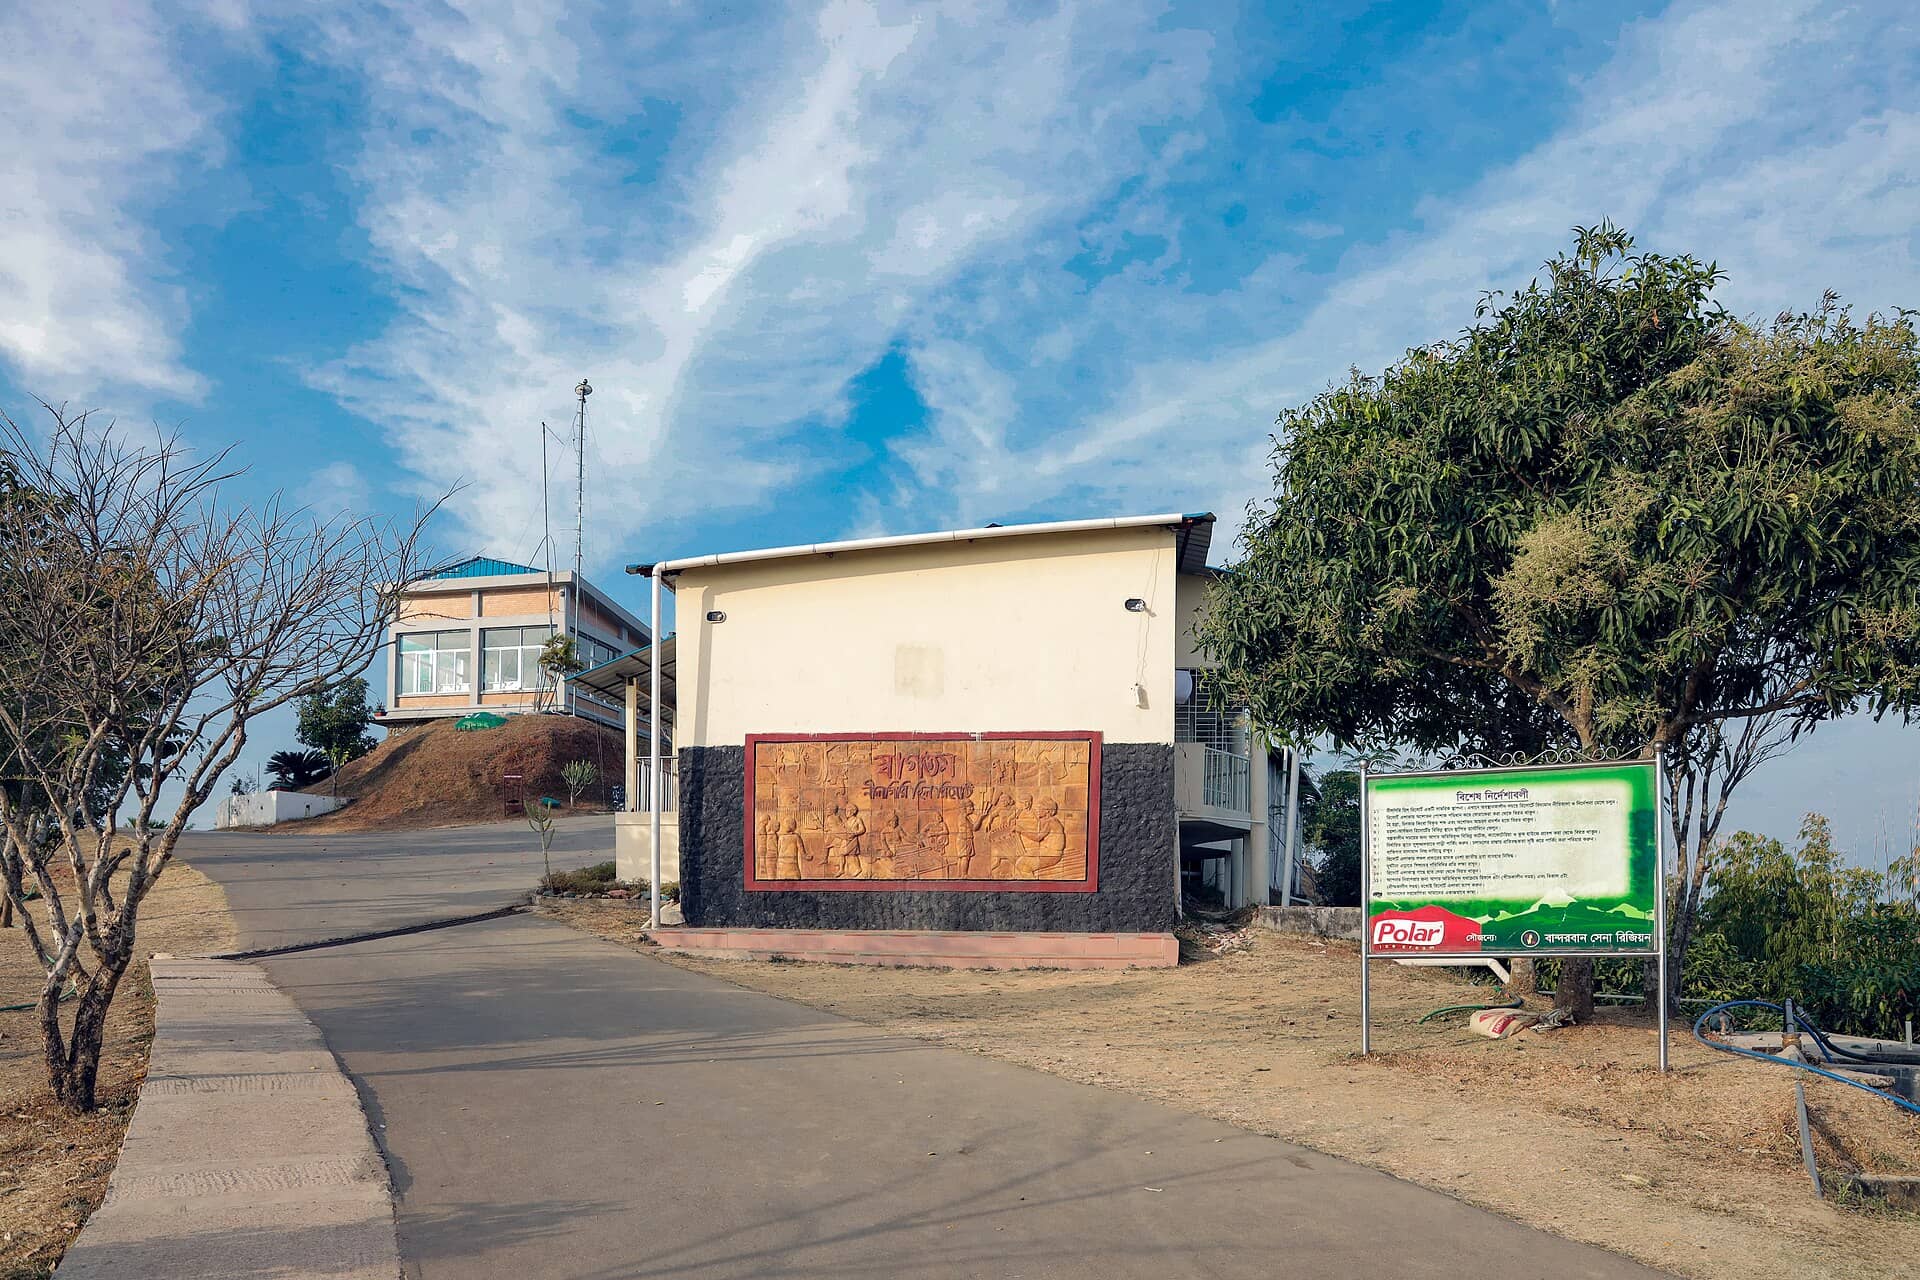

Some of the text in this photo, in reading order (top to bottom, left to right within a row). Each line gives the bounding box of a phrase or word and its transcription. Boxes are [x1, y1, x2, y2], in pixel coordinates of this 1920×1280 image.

[1456, 788, 1528, 801] বিশেষ নির্দেশাবলী
[1378, 922, 1440, 942] Polar
[1544, 930, 1652, 943] বান্দরবান সেনা রিজিয়ন
